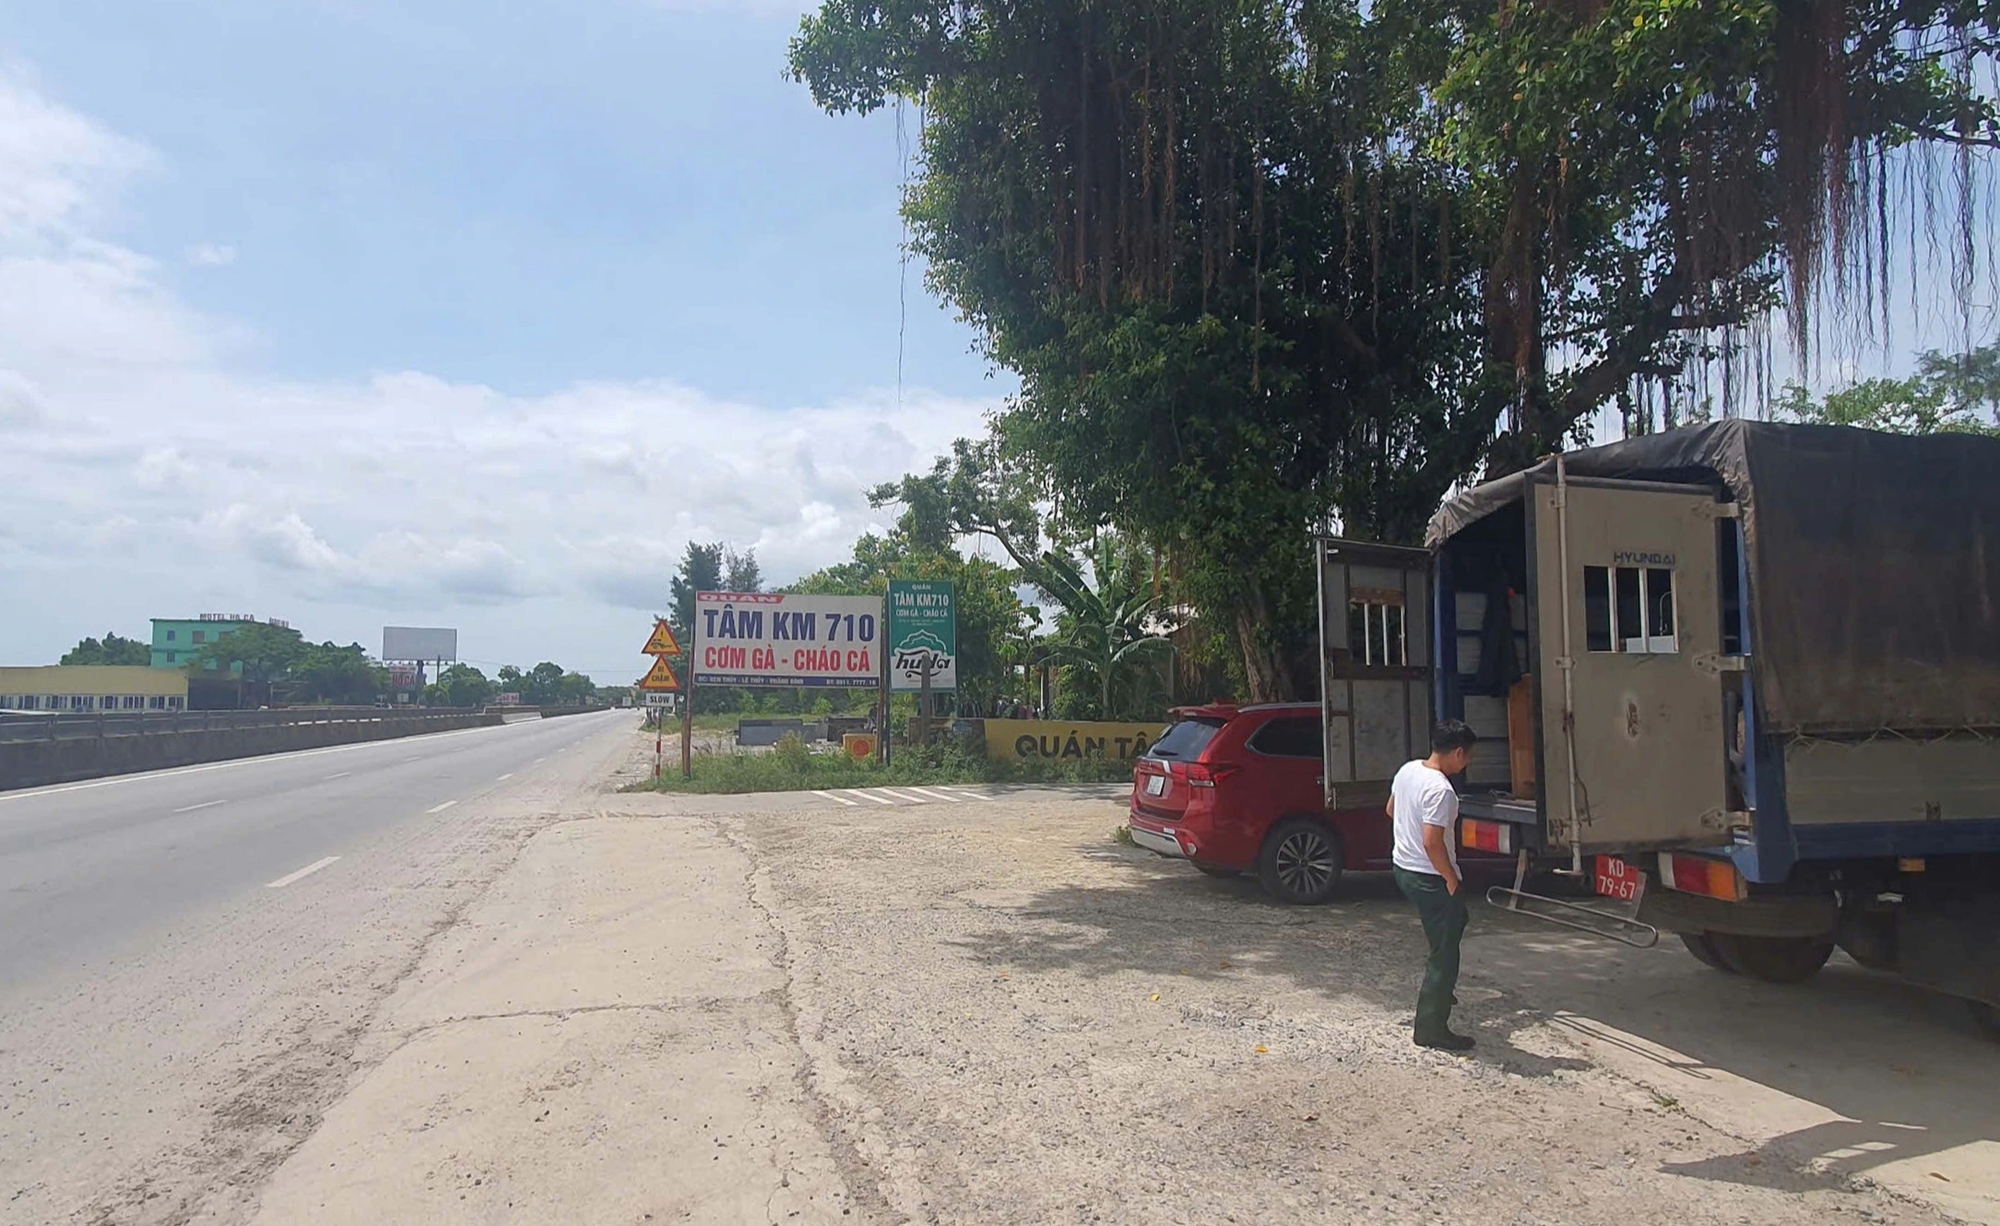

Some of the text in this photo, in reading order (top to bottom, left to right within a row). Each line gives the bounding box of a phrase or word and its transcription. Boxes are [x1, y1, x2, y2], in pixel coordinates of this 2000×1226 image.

[1613, 551, 1676, 565] HYUNDAI
[894, 591, 949, 607] TÂM KM710
[703, 603, 875, 642] TÂM KM 710
[705, 645, 746, 669] CƠM
[752, 644, 776, 670] GÀ
[794, 645, 841, 671] CHÁO
[846, 645, 870, 672] CÁ
[649, 695, 671, 704] SLOW
[1015, 729, 1149, 759] QUÁN TÂ
[1608, 858, 1624, 878] KD
[1599, 875, 1636, 900] 79-67
